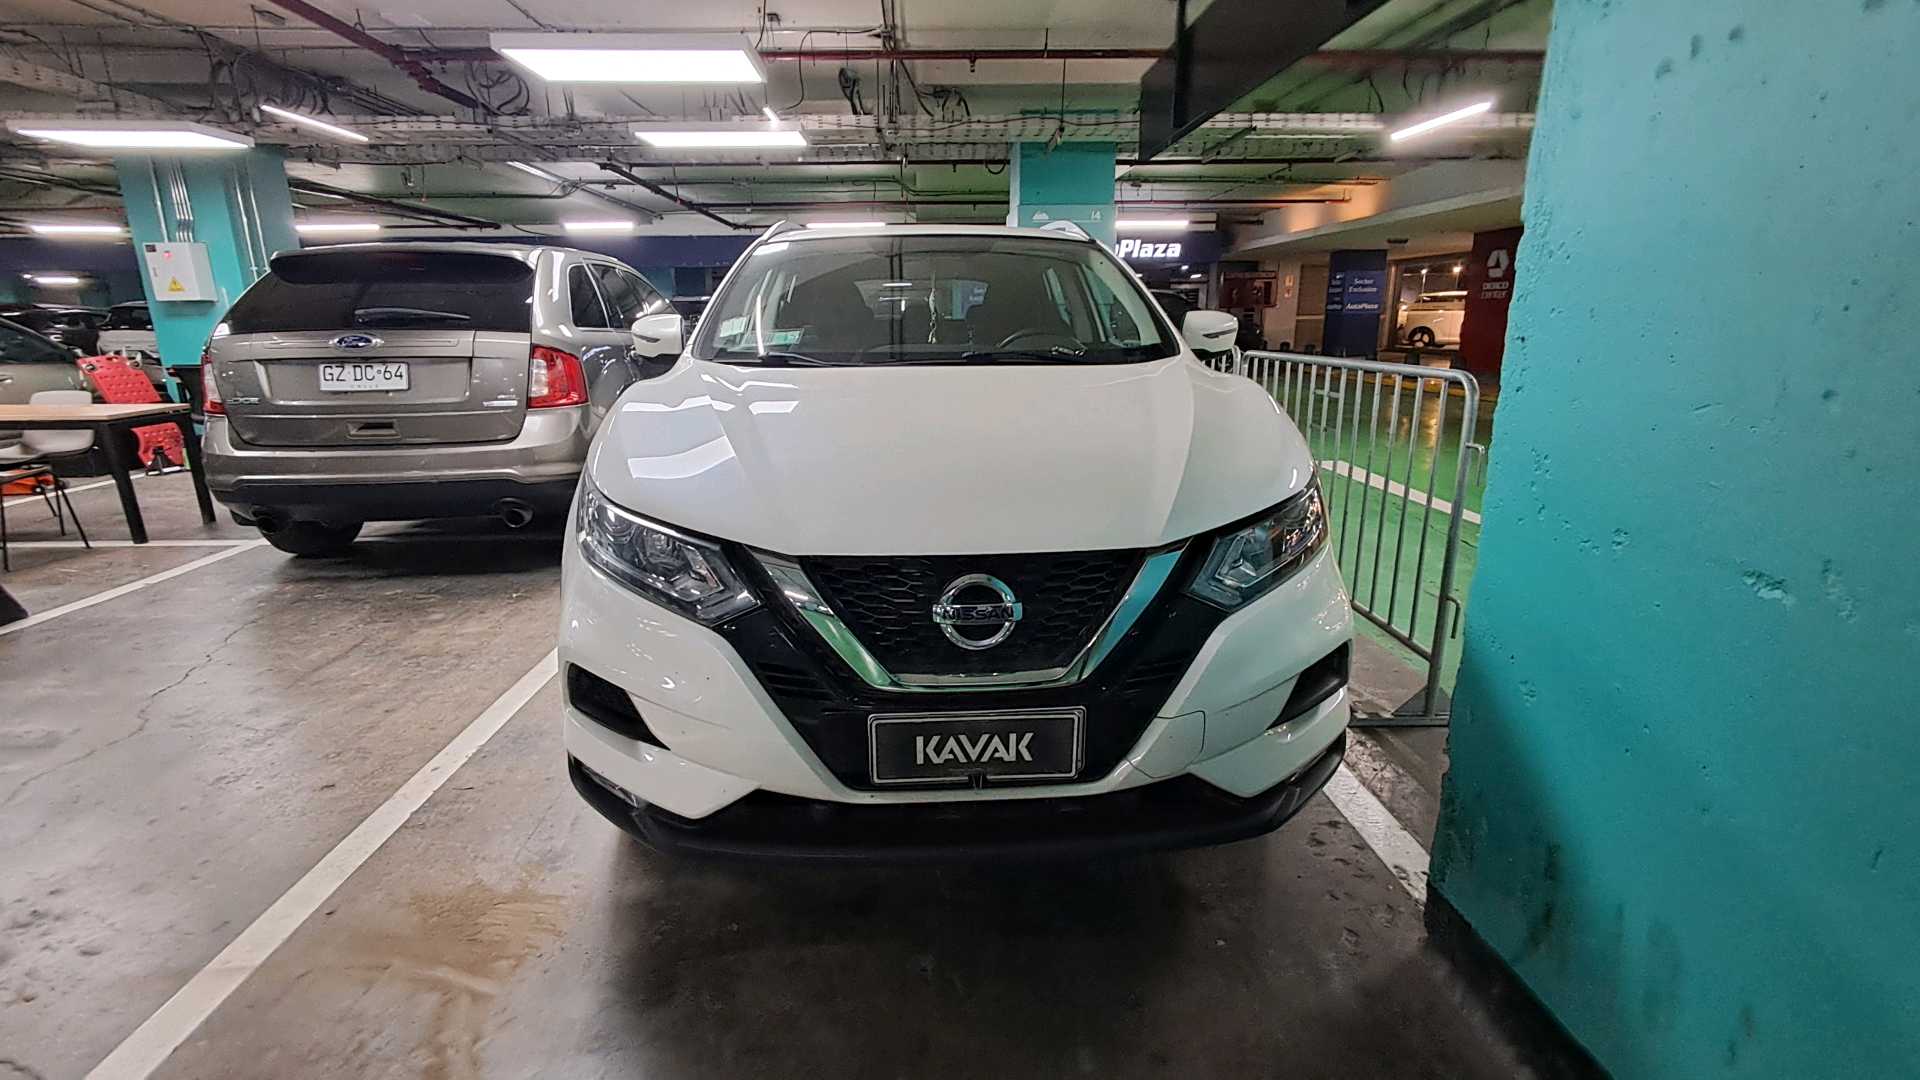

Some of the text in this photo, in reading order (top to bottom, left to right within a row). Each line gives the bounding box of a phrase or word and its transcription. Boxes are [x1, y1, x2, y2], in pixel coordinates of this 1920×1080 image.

[323, 365, 346, 382] GZ
[383, 364, 403, 381] 64
[942, 606, 1014, 621] NISSAN
[916, 732, 1034, 765] KAVAK
